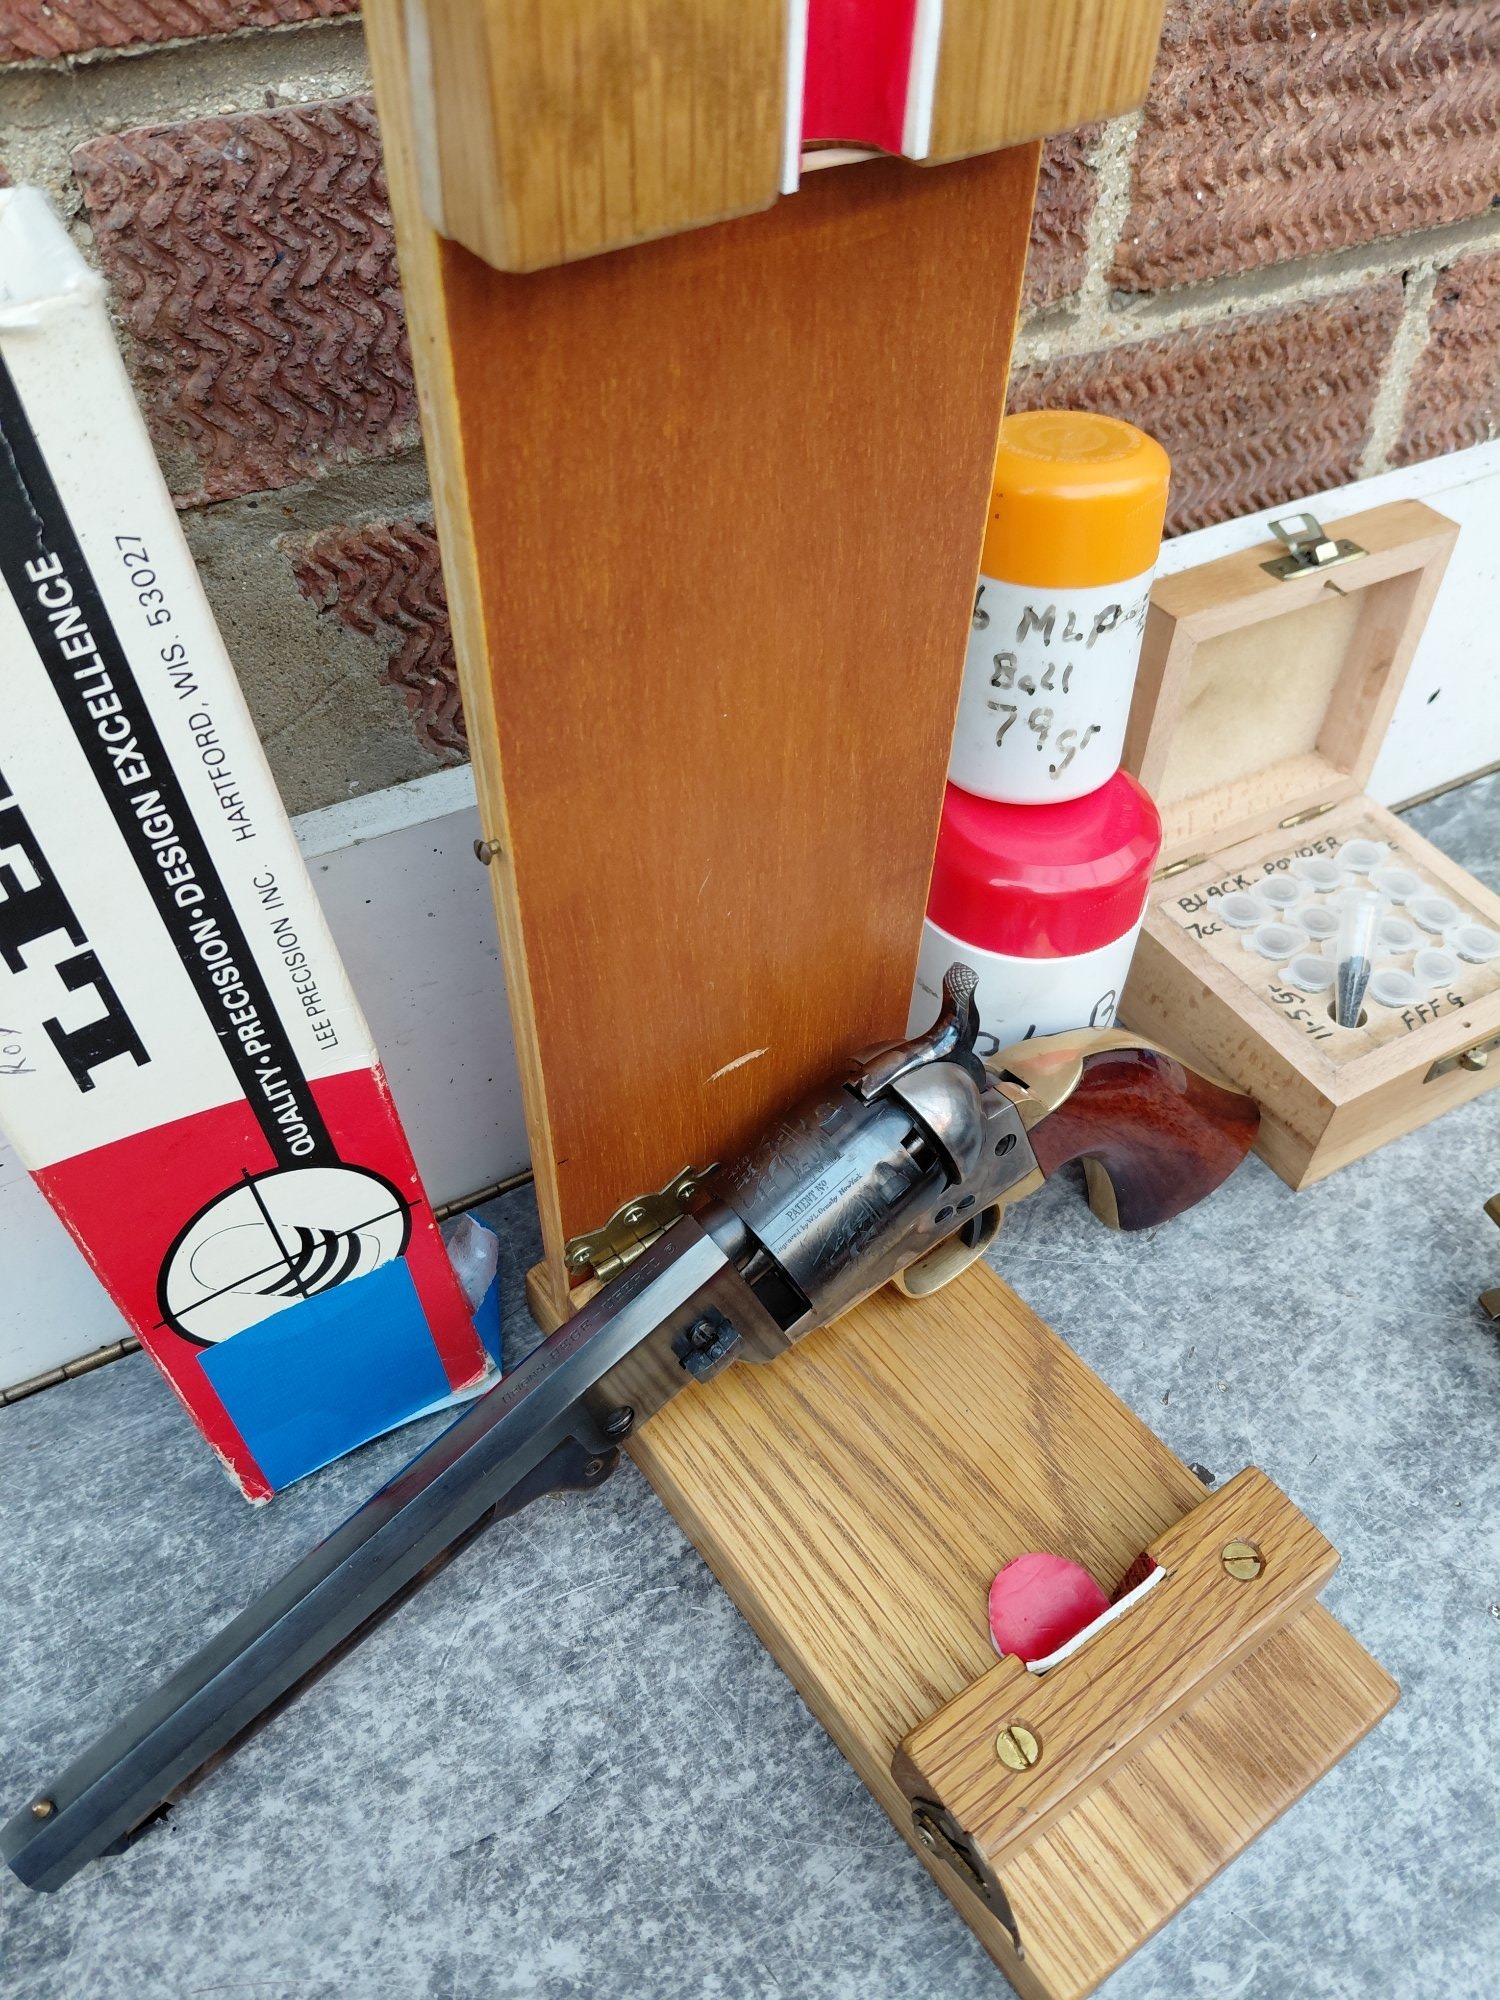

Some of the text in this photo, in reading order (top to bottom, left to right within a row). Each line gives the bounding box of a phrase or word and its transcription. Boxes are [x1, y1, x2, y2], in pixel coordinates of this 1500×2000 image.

[114, 535, 338, 1050] LEE PRECISION INC. HARTFORD, WIS. 53027
[990, 652, 1073, 696] Ball
[25, 552, 315, 1157] QUALITY PRECISION DESIGN EXCELLENCE
[785, 1190, 818, 1222] PATENT
